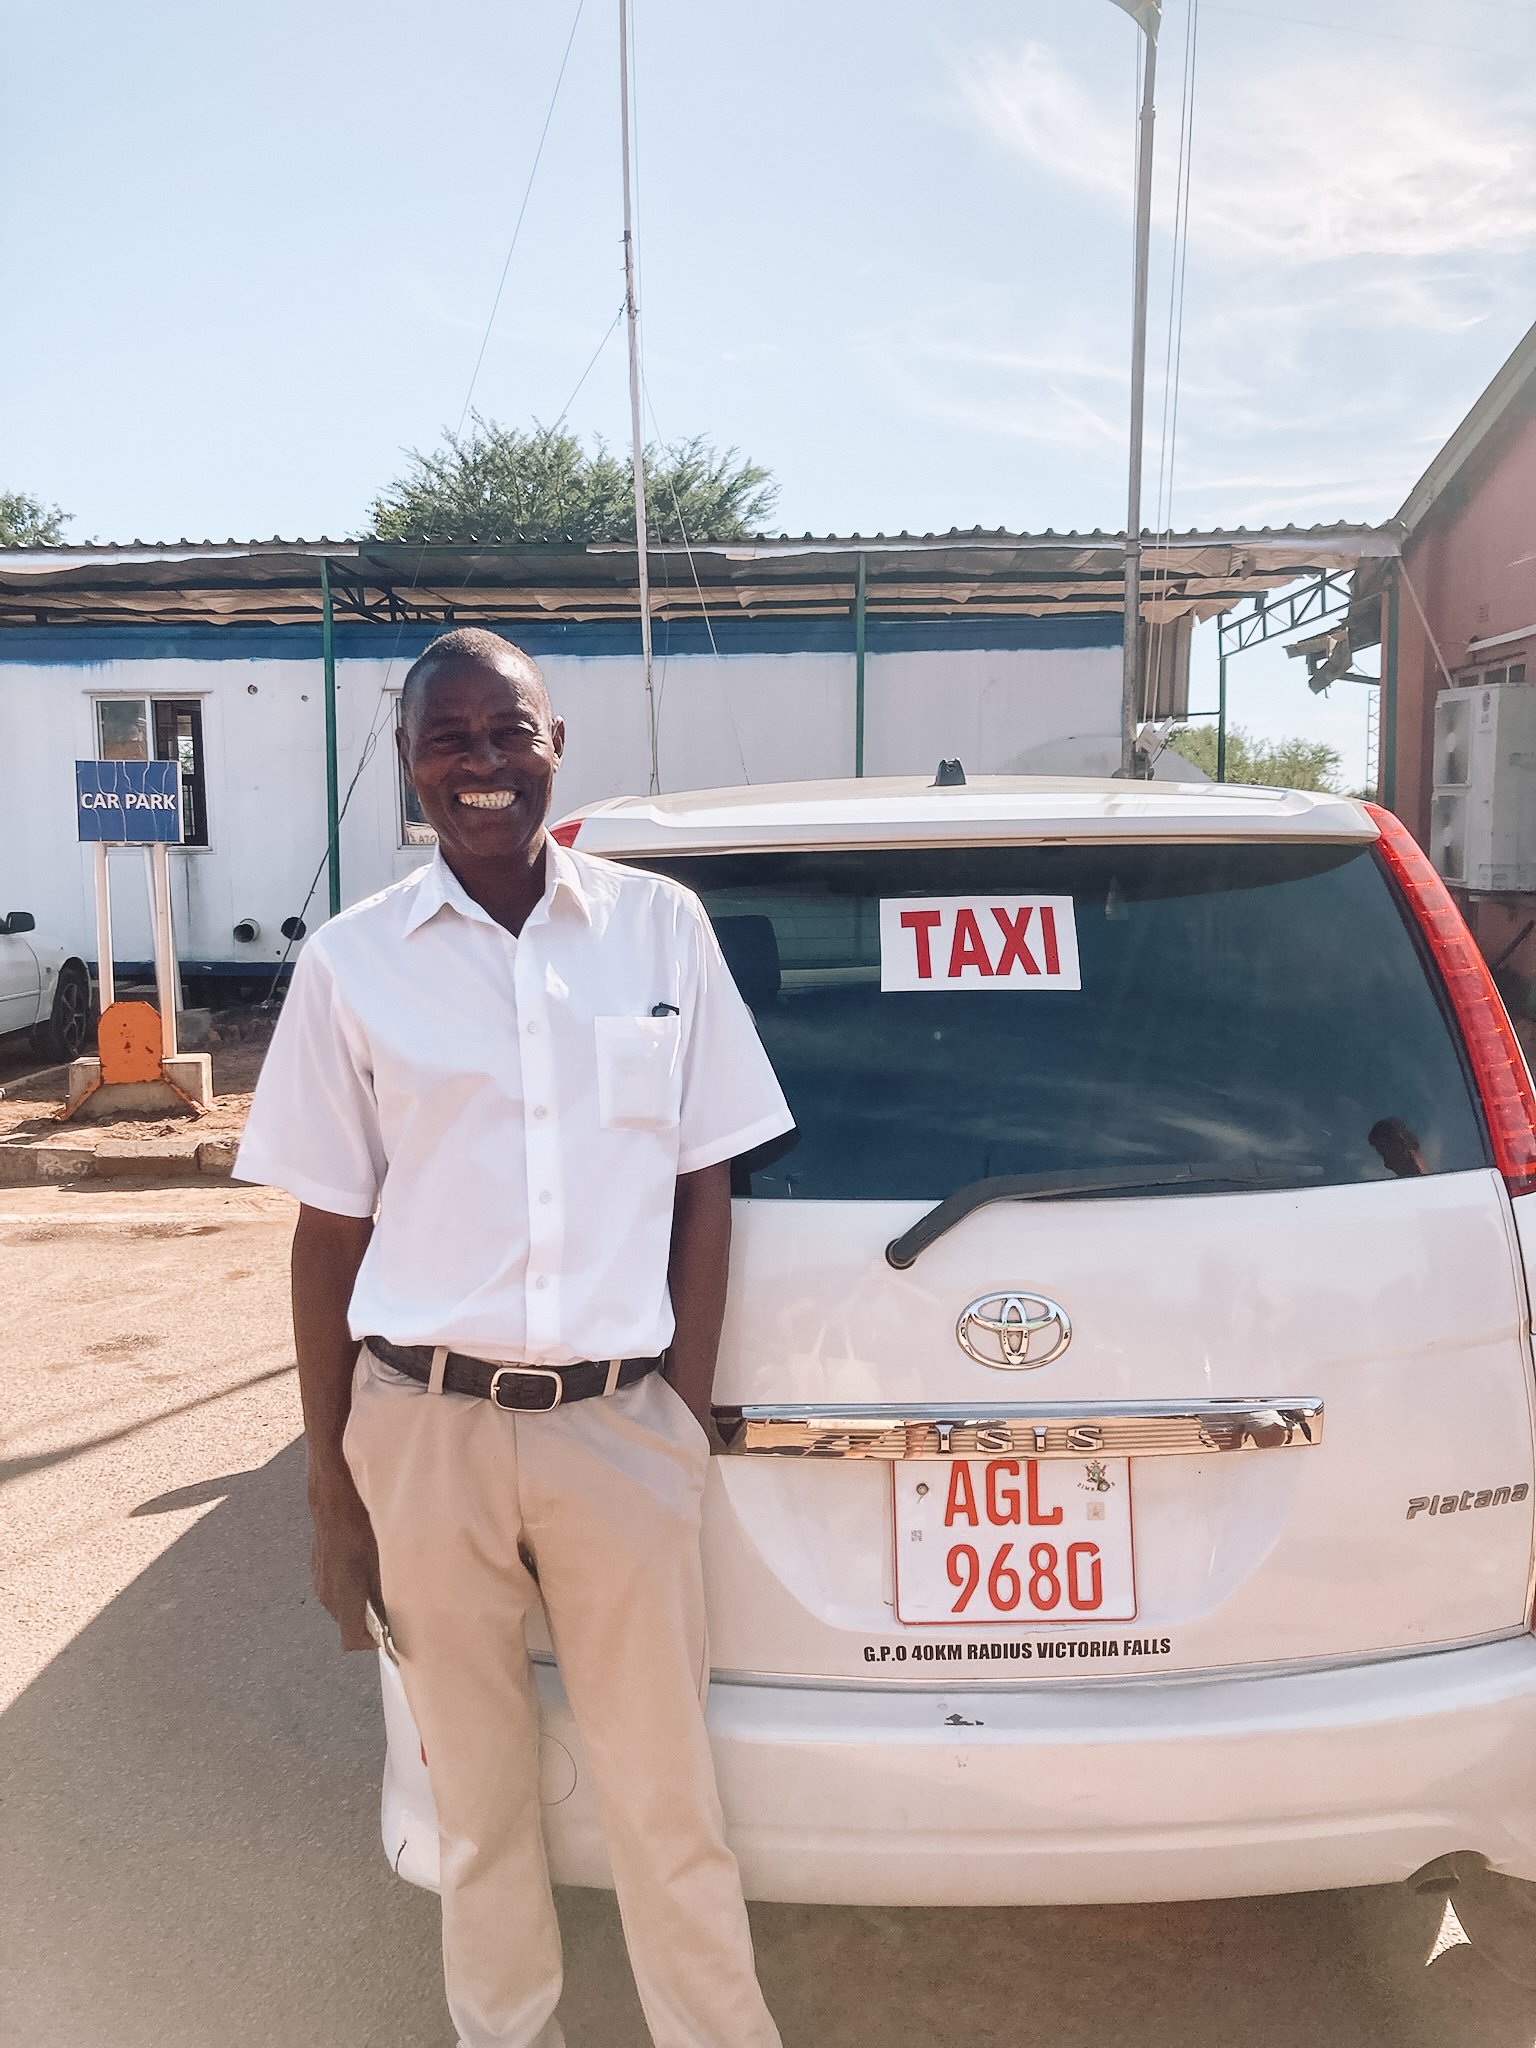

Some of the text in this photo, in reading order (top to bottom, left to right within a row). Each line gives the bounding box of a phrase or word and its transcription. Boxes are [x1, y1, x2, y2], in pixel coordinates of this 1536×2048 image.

[81, 793, 176, 810] CAR PARK
[900, 906, 1060, 978] TAXI
[935, 1424, 1104, 1453] ISIS
[944, 1459, 1063, 1527] AGL
[1406, 1483, 1529, 1520] Platana
[946, 1542, 1103, 1613] 9680
[863, 1638, 1171, 1662] G.P.O 40KM RADIUS VICTORIA FALLS
